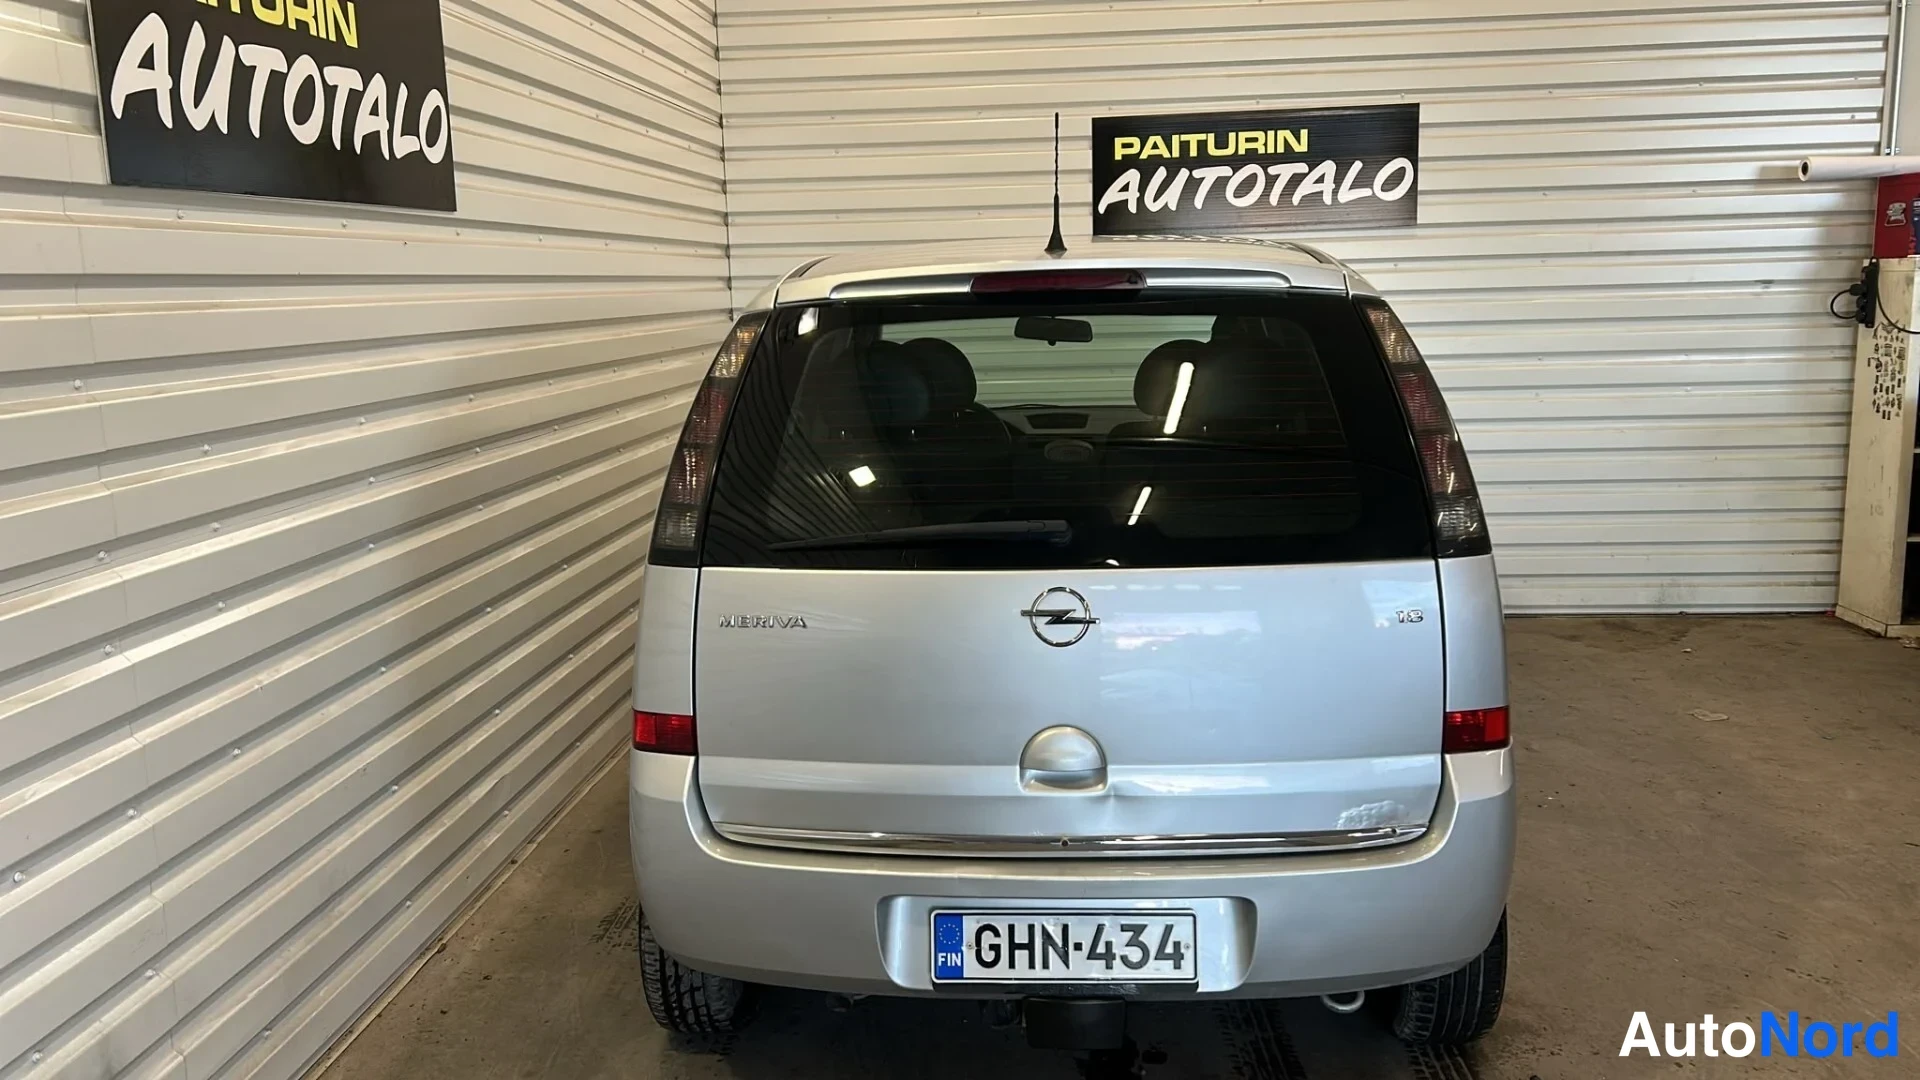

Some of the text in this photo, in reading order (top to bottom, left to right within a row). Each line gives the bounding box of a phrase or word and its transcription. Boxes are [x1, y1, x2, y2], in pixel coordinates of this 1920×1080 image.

[110, 12, 449, 164] AUTOTALO
[1114, 129, 1309, 161] PAITURIN
[1098, 157, 1415, 214] AUTOTALO
[719, 614, 808, 629] MERIVA
[938, 952, 962, 967] FIN
[974, 922, 1185, 970] GHN-434
